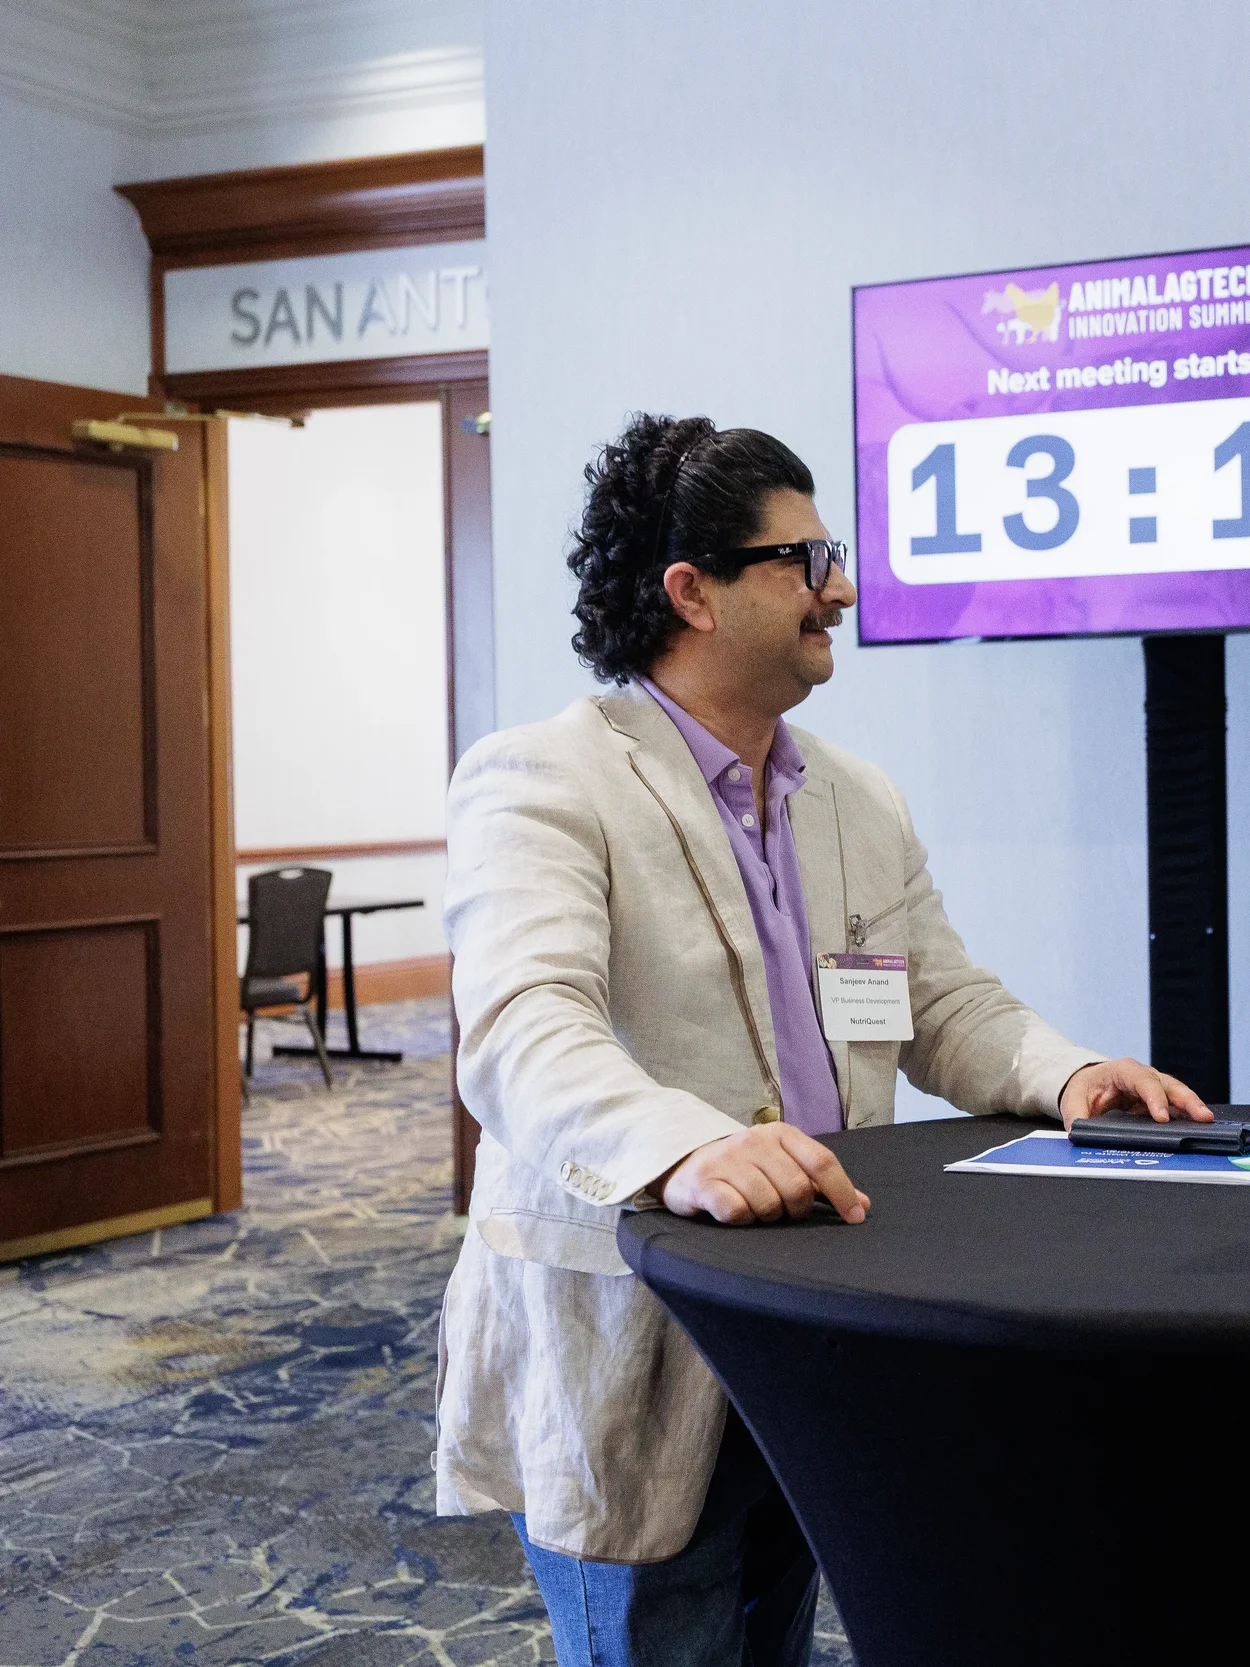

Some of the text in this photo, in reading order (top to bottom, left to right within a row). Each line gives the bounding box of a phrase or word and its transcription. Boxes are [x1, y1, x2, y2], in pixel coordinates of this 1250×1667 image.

[229, 265, 488, 347] SAN ANT
[1068, 306, 1183, 341] INNOVATION
[988, 368, 1049, 396] Next
[1056, 355, 1167, 390] meeting
[840, 977, 889, 986] Sanjeev Anand
[850, 1017, 886, 1025] NutriQuest
